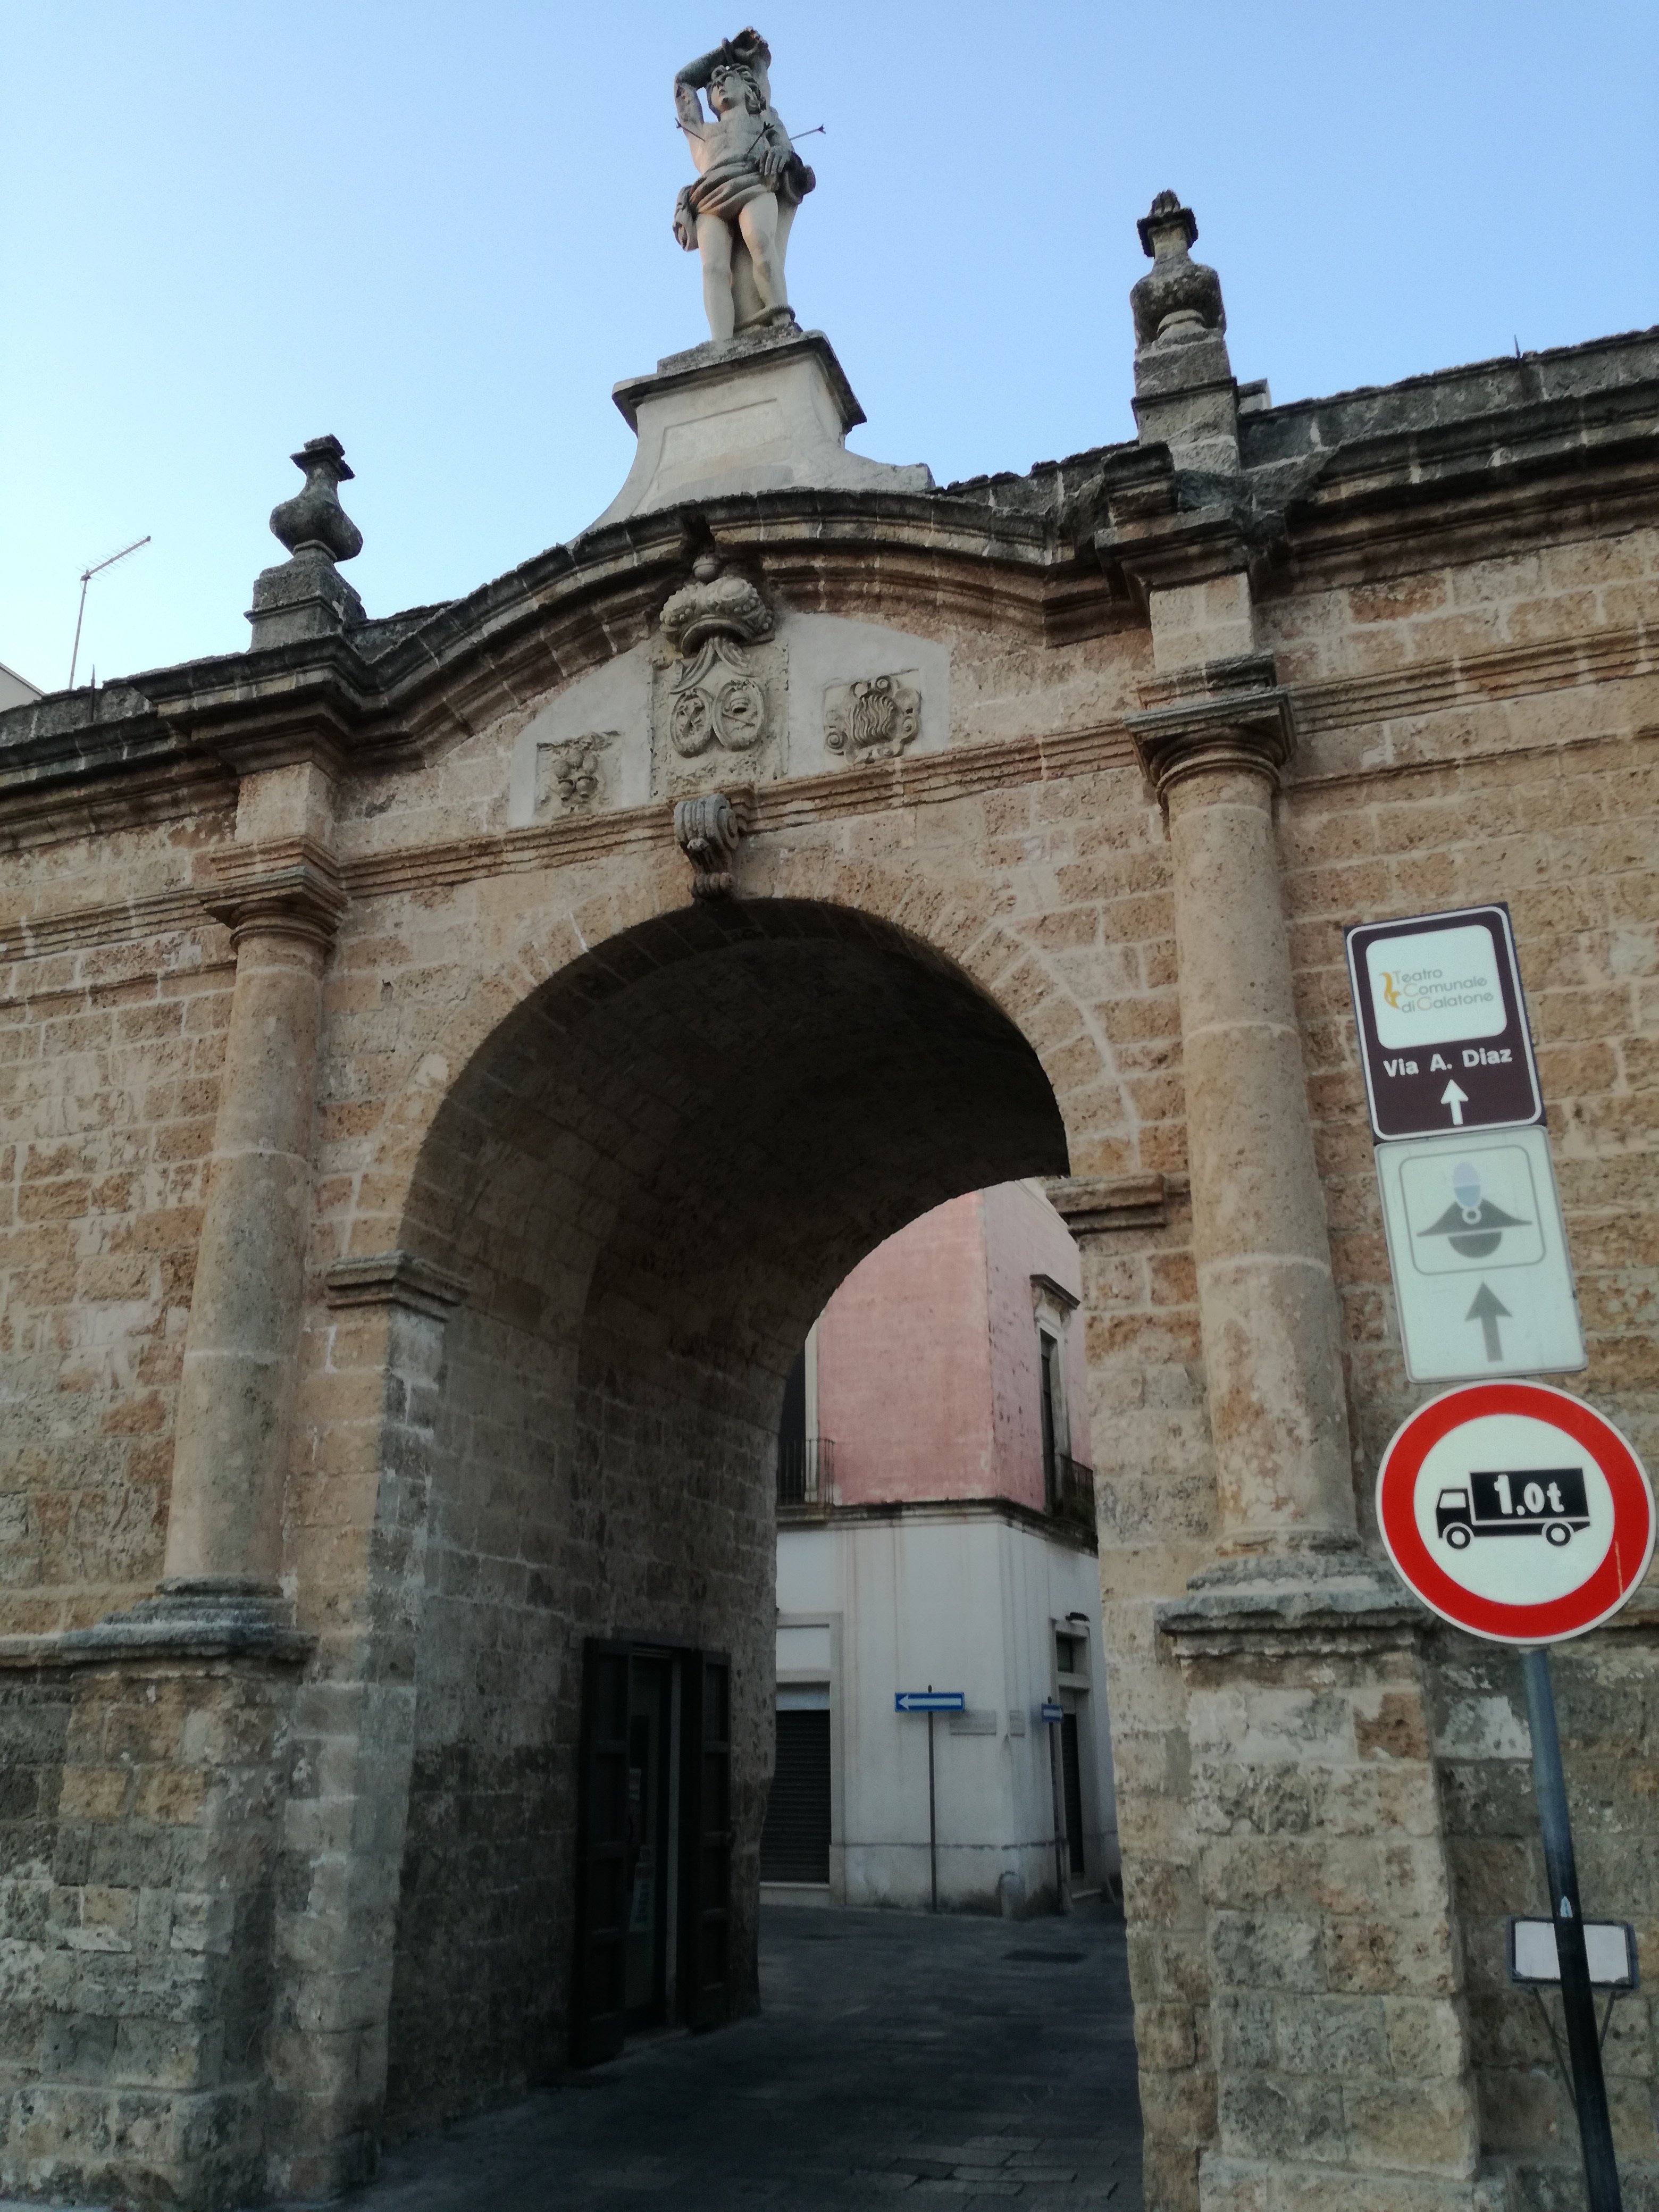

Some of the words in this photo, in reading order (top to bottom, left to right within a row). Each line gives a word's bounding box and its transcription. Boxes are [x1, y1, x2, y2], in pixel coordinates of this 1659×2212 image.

[1392, 969, 1443, 984] Teatro
[1403, 976, 1487, 998] Comunale
[1383, 1058, 1419, 1077] Via
[1430, 1053, 1453, 1072] A.
[1462, 1048, 1513, 1068] Diaz
[1494, 1474, 1565, 1515] 1.0t
